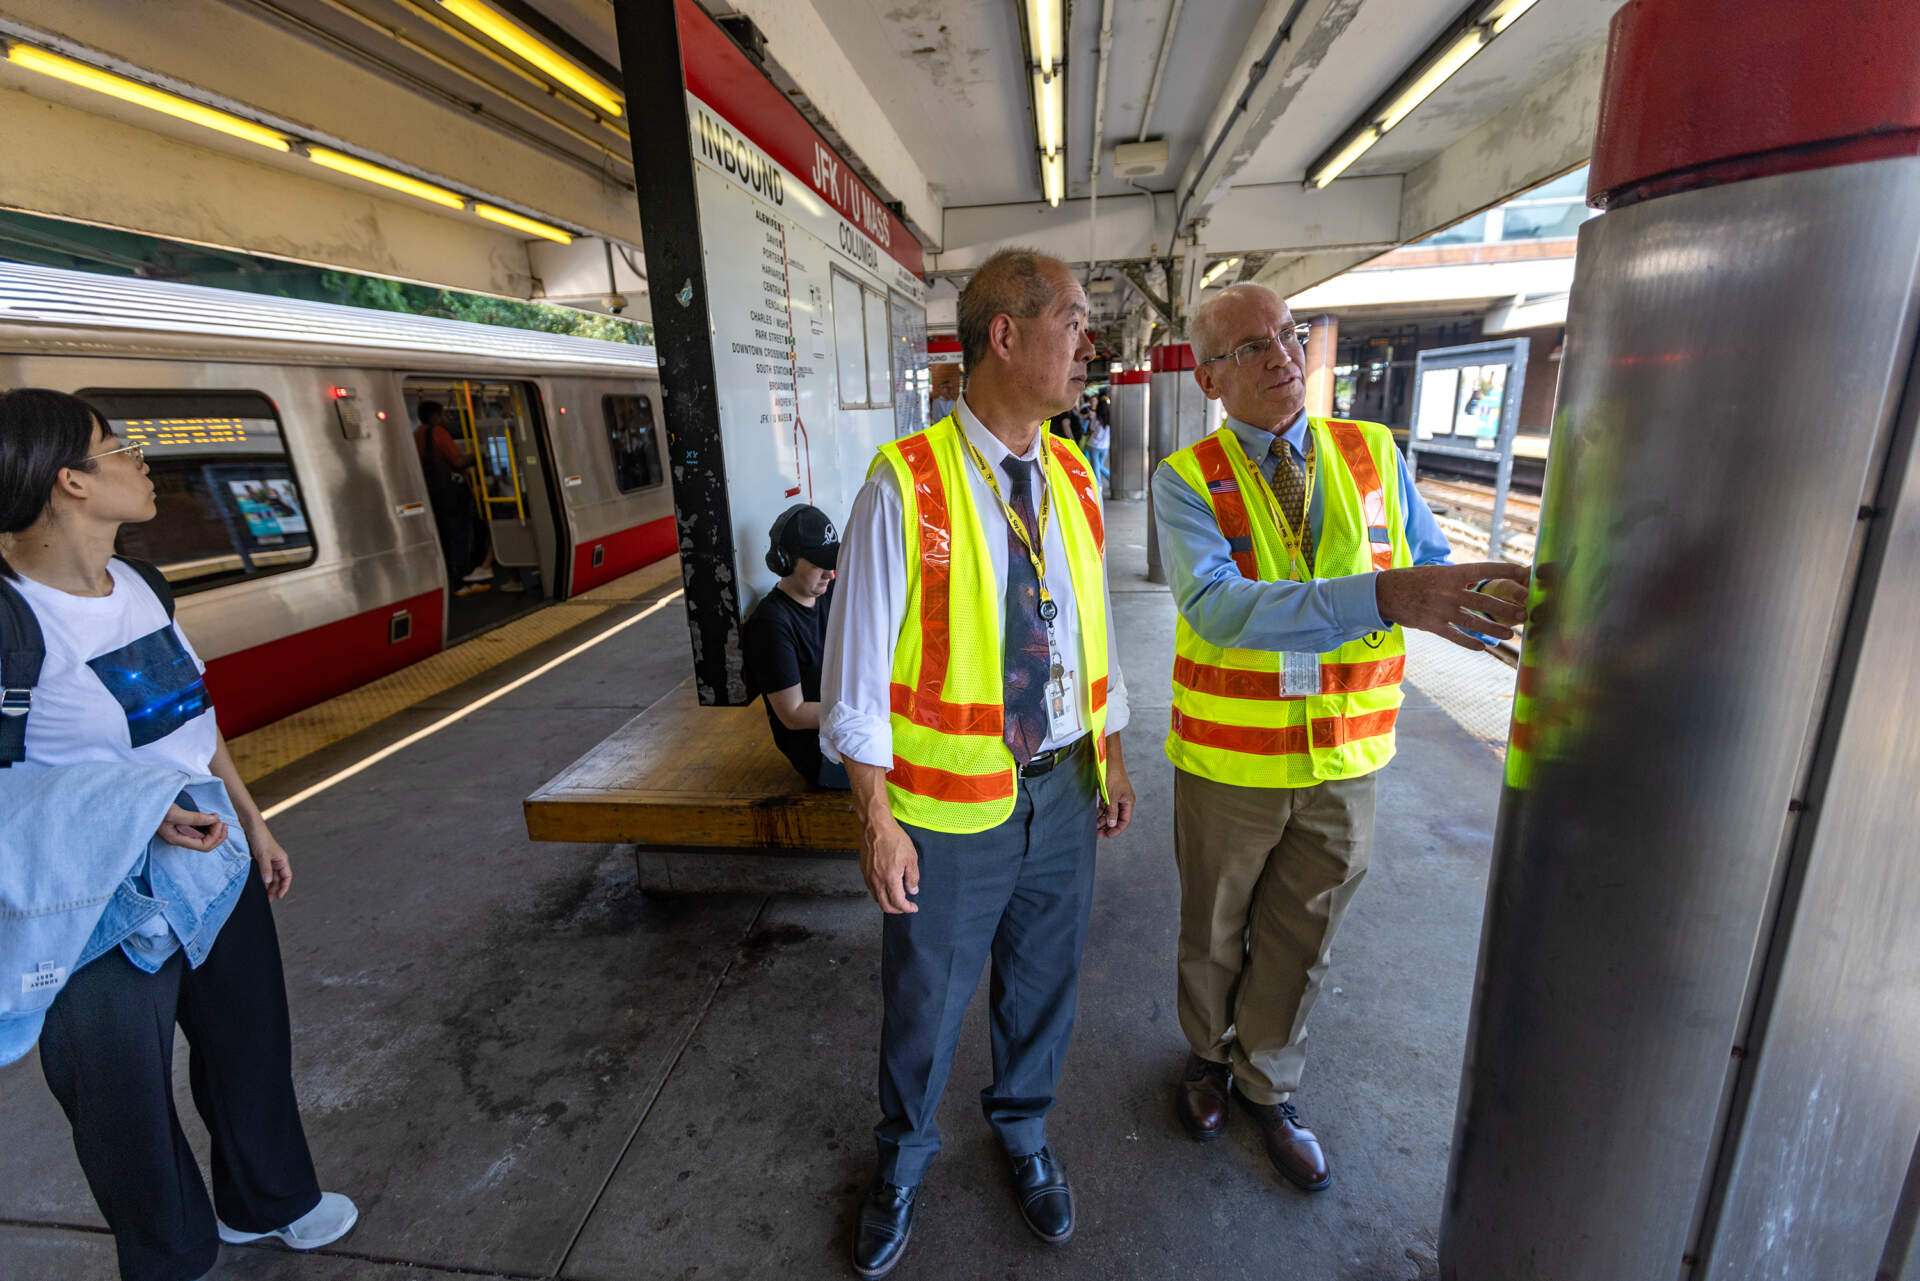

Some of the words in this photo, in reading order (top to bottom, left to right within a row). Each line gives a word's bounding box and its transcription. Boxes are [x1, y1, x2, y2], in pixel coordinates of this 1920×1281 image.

[698, 109, 784, 206] INBOUND
[812, 141, 841, 206] JFK
[850, 178, 860, 222] U
[862, 190, 890, 248] MASS
[839, 220, 879, 272] COLUMBIA
[750, 310, 772, 325] CHARLES
[755, 329, 768, 340] PARK
[768, 332, 785, 344] STREET
[732, 342, 763, 356] DOWNTOWN
[756, 364, 772, 374] SOUTH
